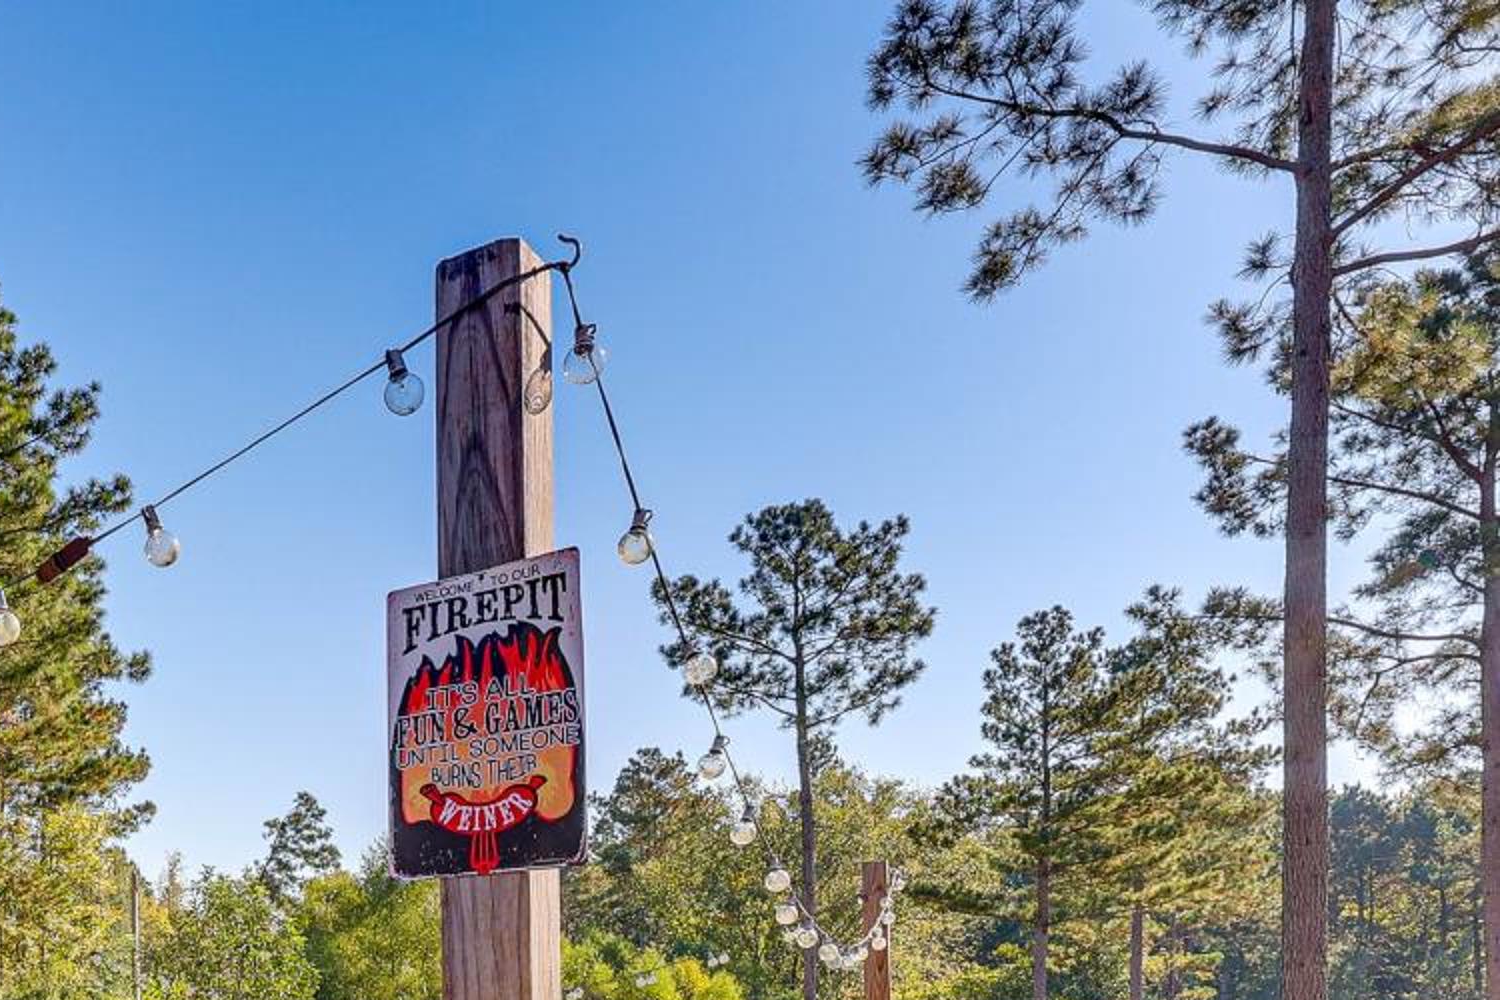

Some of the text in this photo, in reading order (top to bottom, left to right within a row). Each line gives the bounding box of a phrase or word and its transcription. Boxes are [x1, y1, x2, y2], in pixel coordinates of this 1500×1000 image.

[414, 564, 541, 602] WELCOME TO OUR
[402, 571, 567, 655] FIREPIT
[426, 673, 534, 710] IT'S ALL
[397, 689, 579, 748] FUN & GAMES
[397, 724, 580, 769] UNTIL SOMEONE
[431, 754, 537, 788] BURNS THEIR
[439, 792, 533, 831] WEINER
